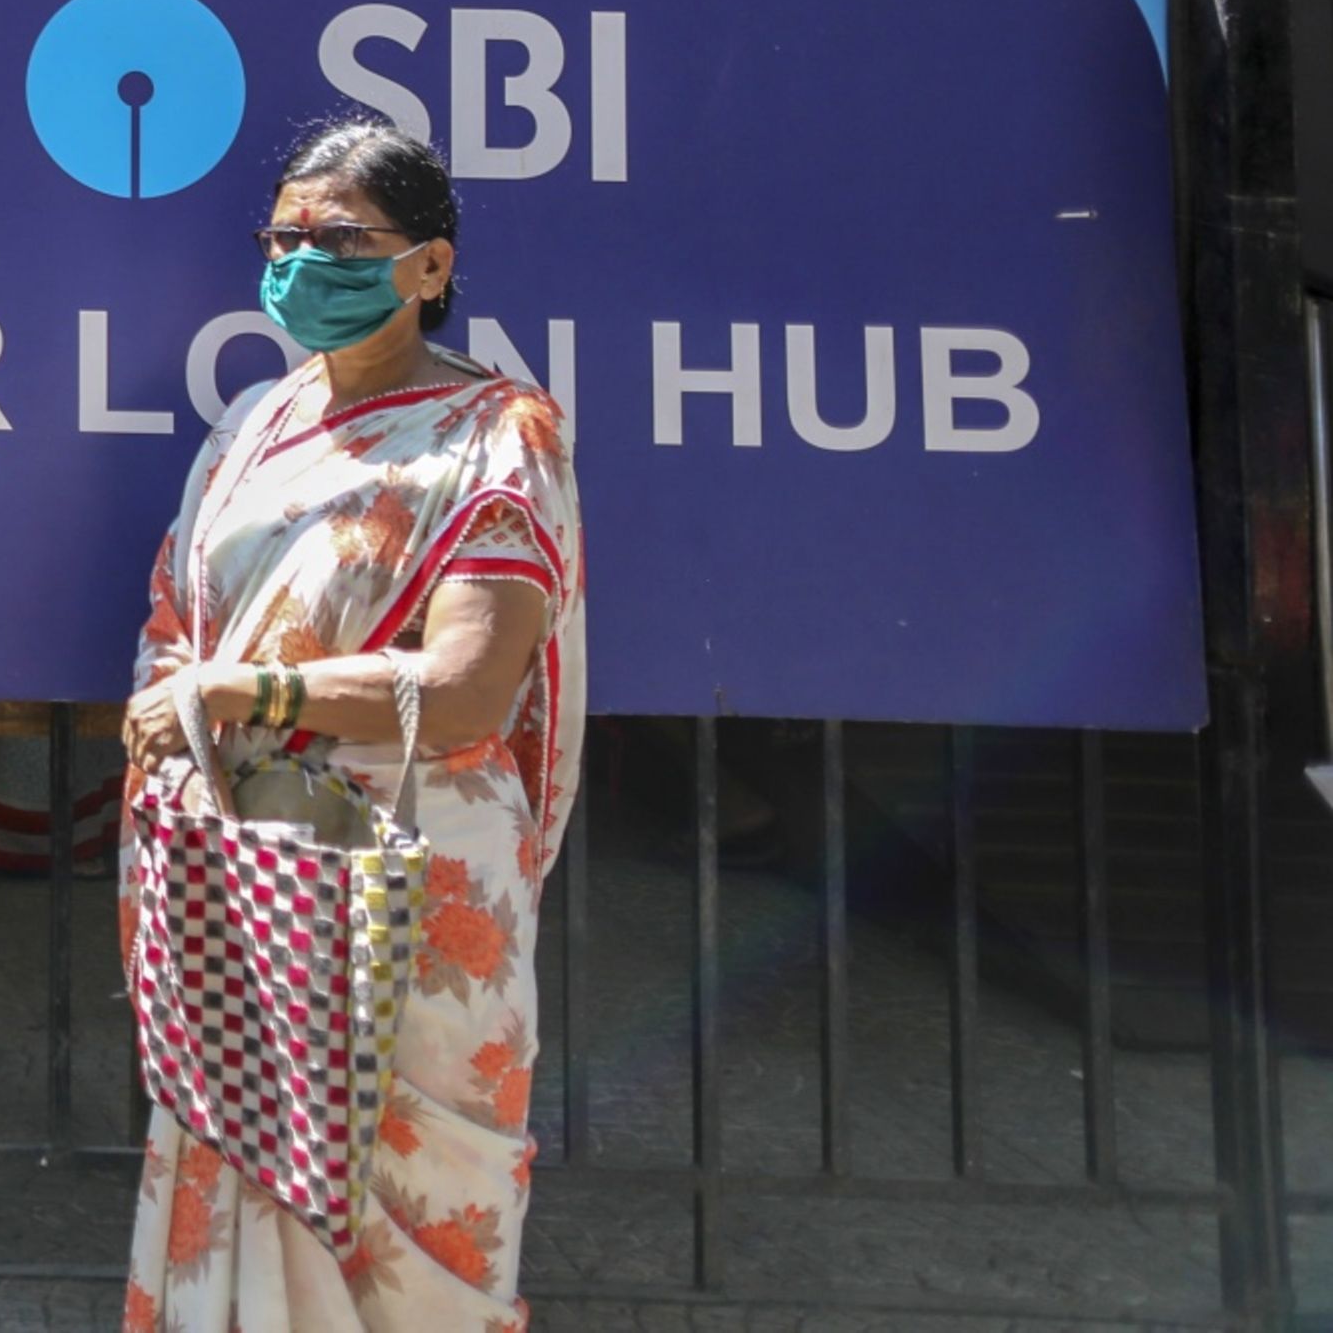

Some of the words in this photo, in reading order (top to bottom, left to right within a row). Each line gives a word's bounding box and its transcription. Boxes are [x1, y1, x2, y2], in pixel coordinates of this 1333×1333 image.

[318, 3, 627, 182] SBI
[78, 308, 576, 442] LON
[651, 320, 1041, 454] HUB
